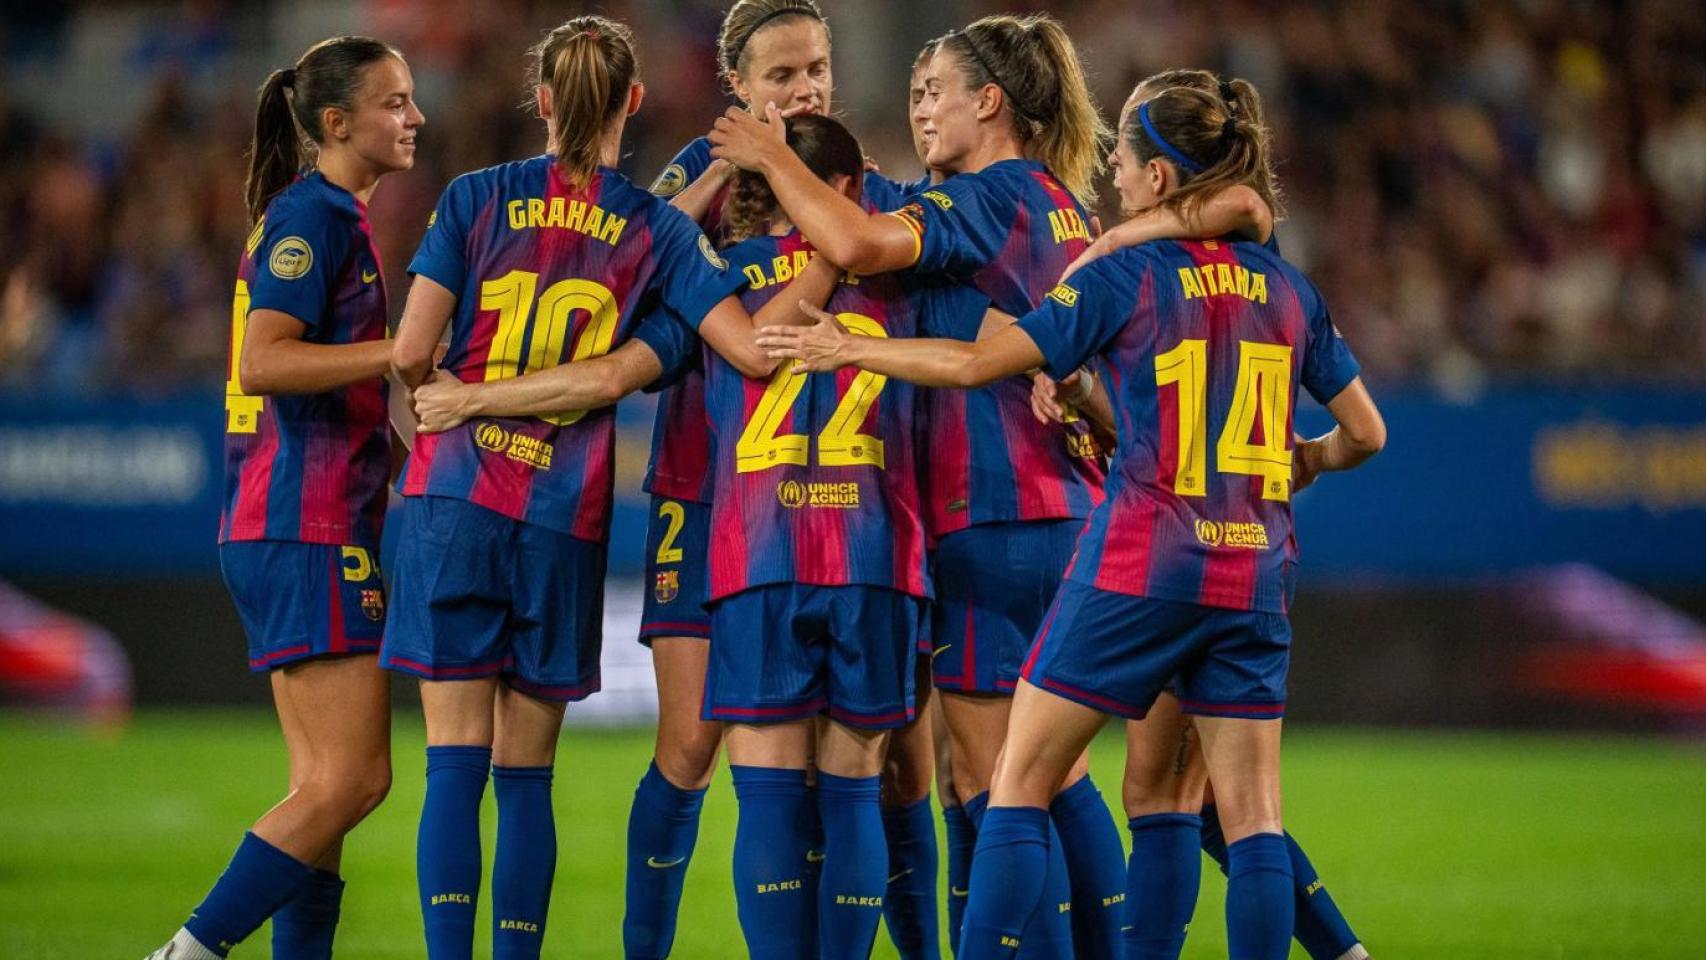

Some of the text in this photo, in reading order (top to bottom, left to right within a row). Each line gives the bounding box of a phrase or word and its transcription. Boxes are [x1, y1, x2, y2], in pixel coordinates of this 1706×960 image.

[508, 197, 626, 246] GRAHAM
[1178, 264, 1268, 304] AITANA
[480, 270, 619, 426] 10
[736, 312, 885, 474] 22
[1155, 339, 1292, 502] 14
[507, 445, 552, 466] ACNUR
[511, 433, 554, 457] UNHCR
[808, 482, 858, 494] UNHCR
[809, 494, 859, 504] ACNUR
[656, 501, 684, 564] 2
[1225, 522, 1266, 535] UNHCR
[1225, 533, 1269, 545] ACNUR
